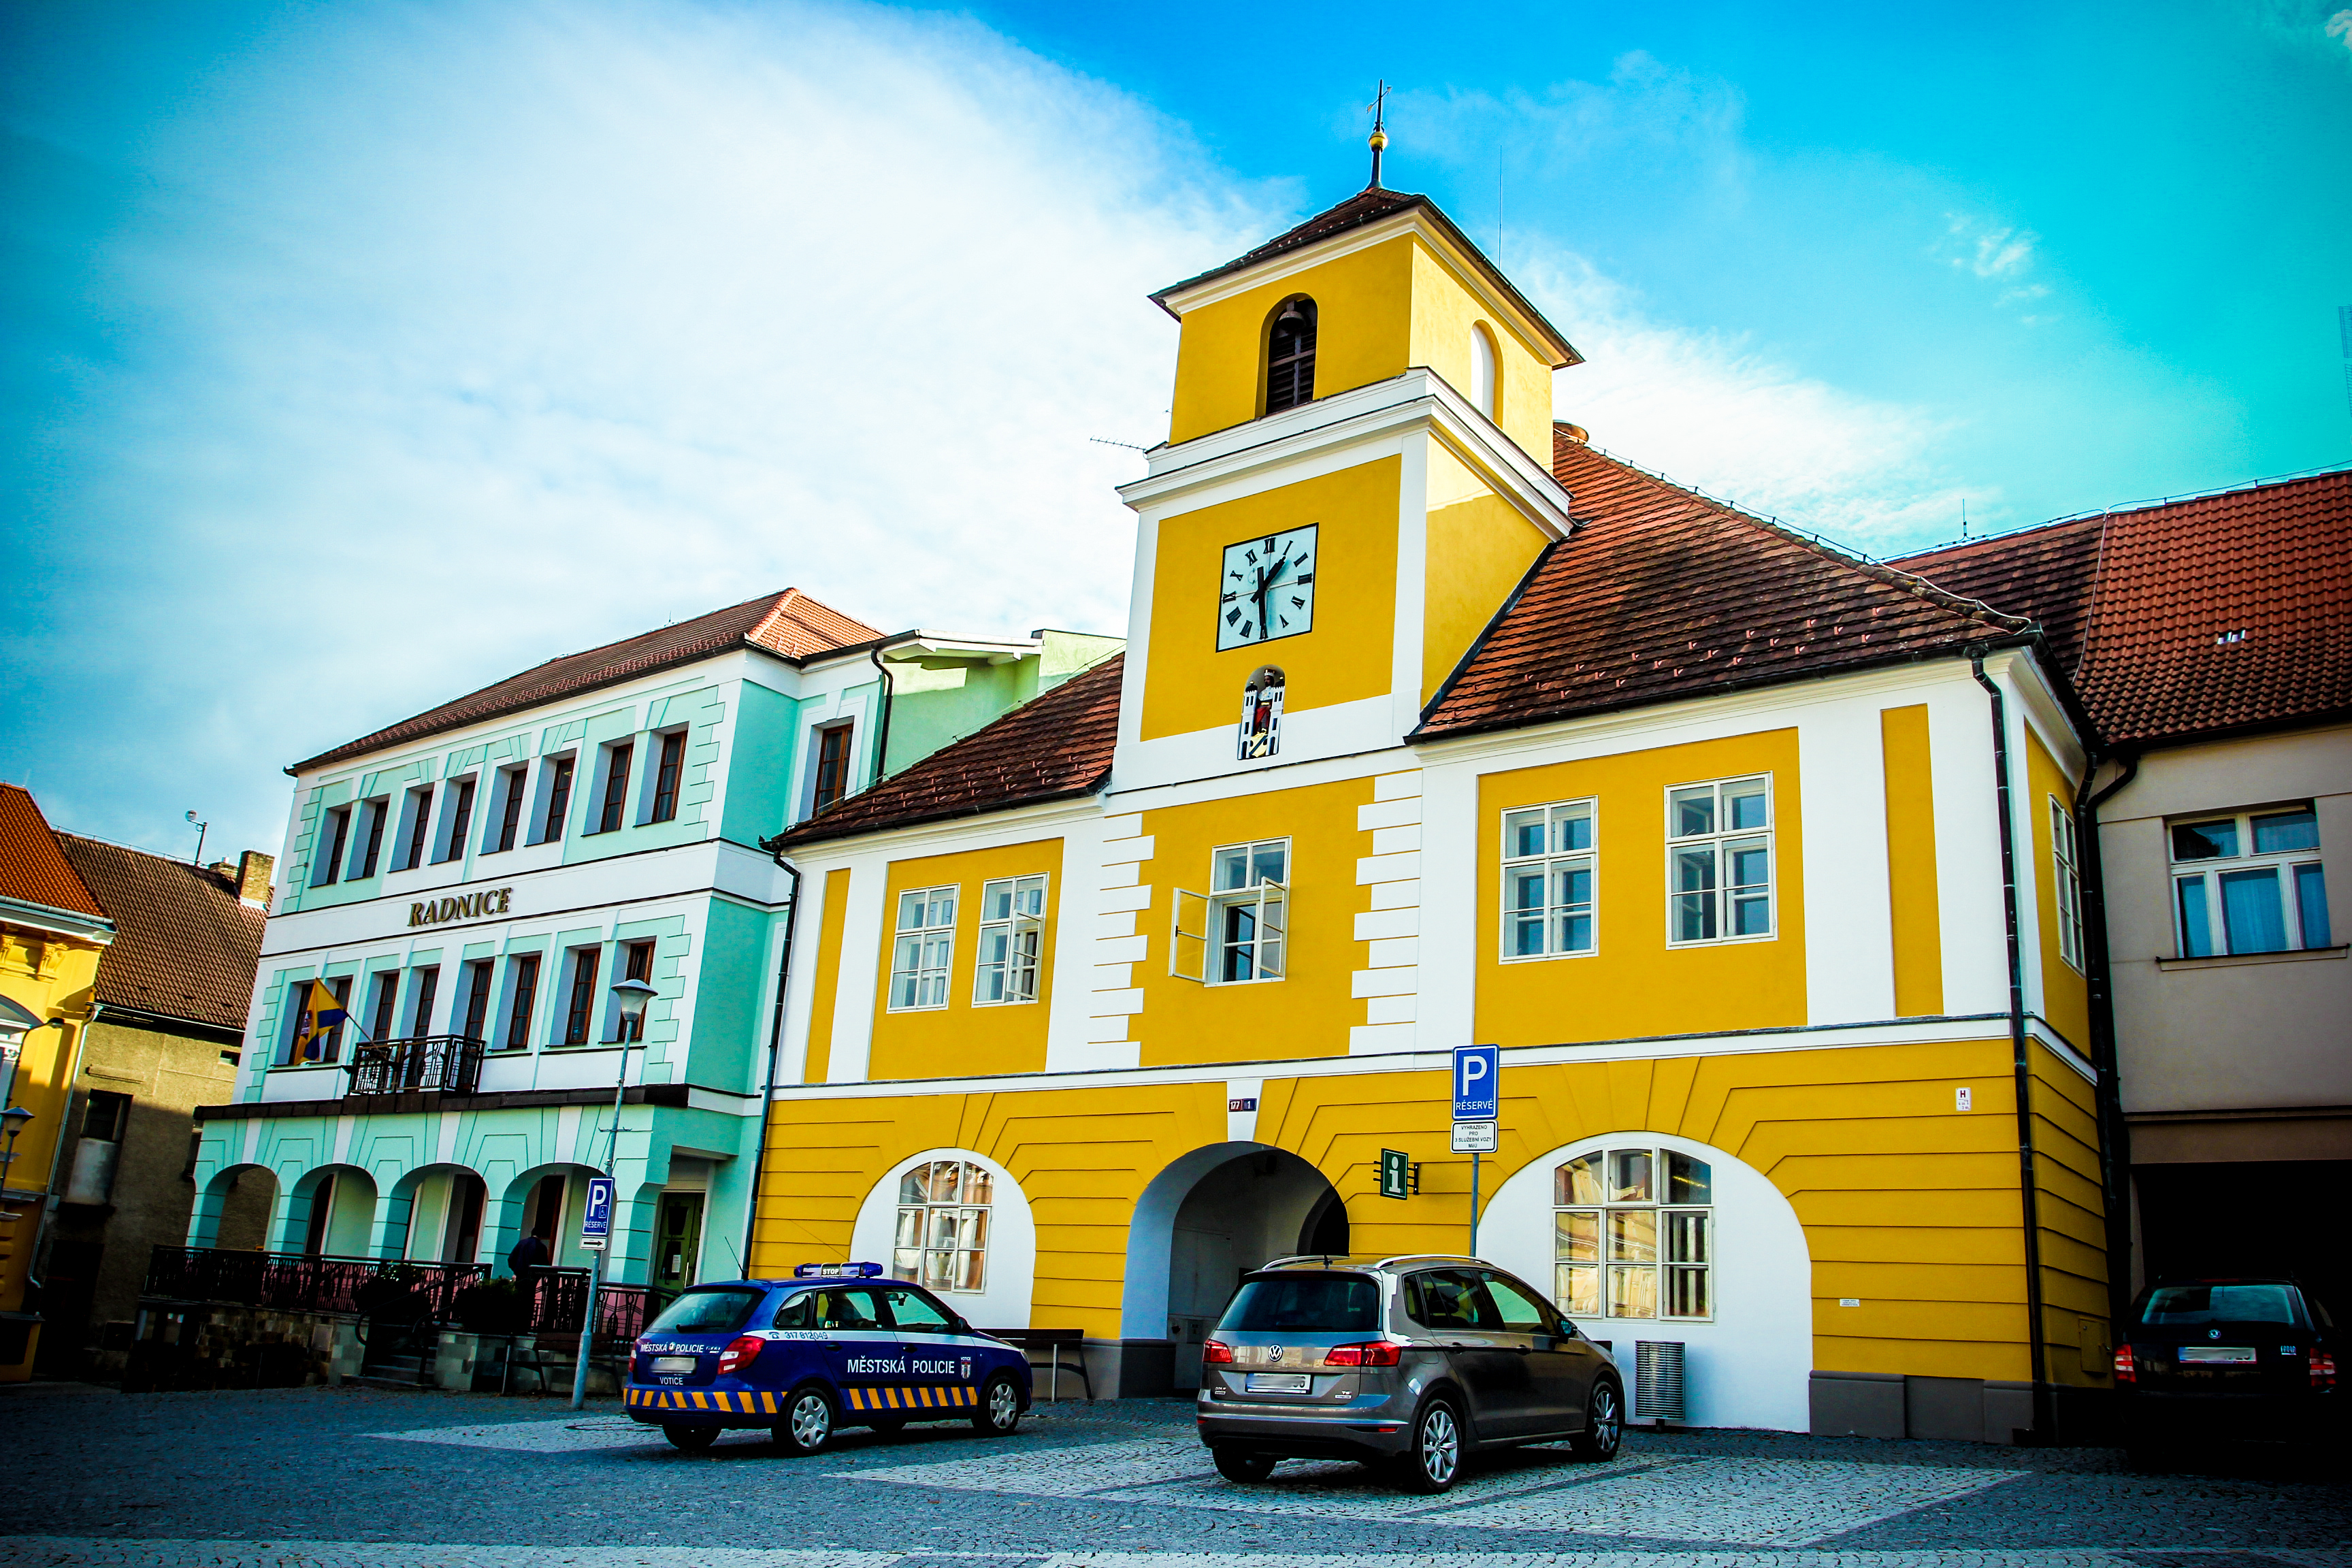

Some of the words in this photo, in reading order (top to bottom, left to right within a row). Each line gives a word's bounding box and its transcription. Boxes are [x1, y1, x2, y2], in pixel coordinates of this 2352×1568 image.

[1263, 537, 1276, 554] XII
[1283, 540, 1293, 555] I
[1245, 549, 1258, 566] XI
[1230, 570, 1243, 581] X
[1222, 591, 1237, 604] IX
[1279, 614, 1289, 628] V
[407, 887, 512, 926] RADNICE
[1463, 1055, 1488, 1096] P
[1230, 1100, 1240, 1109] 177
[1456, 1098, 1493, 1110] RÉSERVÉ
[589, 1185, 606, 1217] P
[585, 1220, 606, 1228] RÉSERVÉ
[675, 1344, 704, 1353] POLICIE
[847, 1355, 906, 1373] MĚSTSKÁ
[912, 1360, 955, 1374] POLICIE
[659, 1377, 683, 1385] VOTICE
